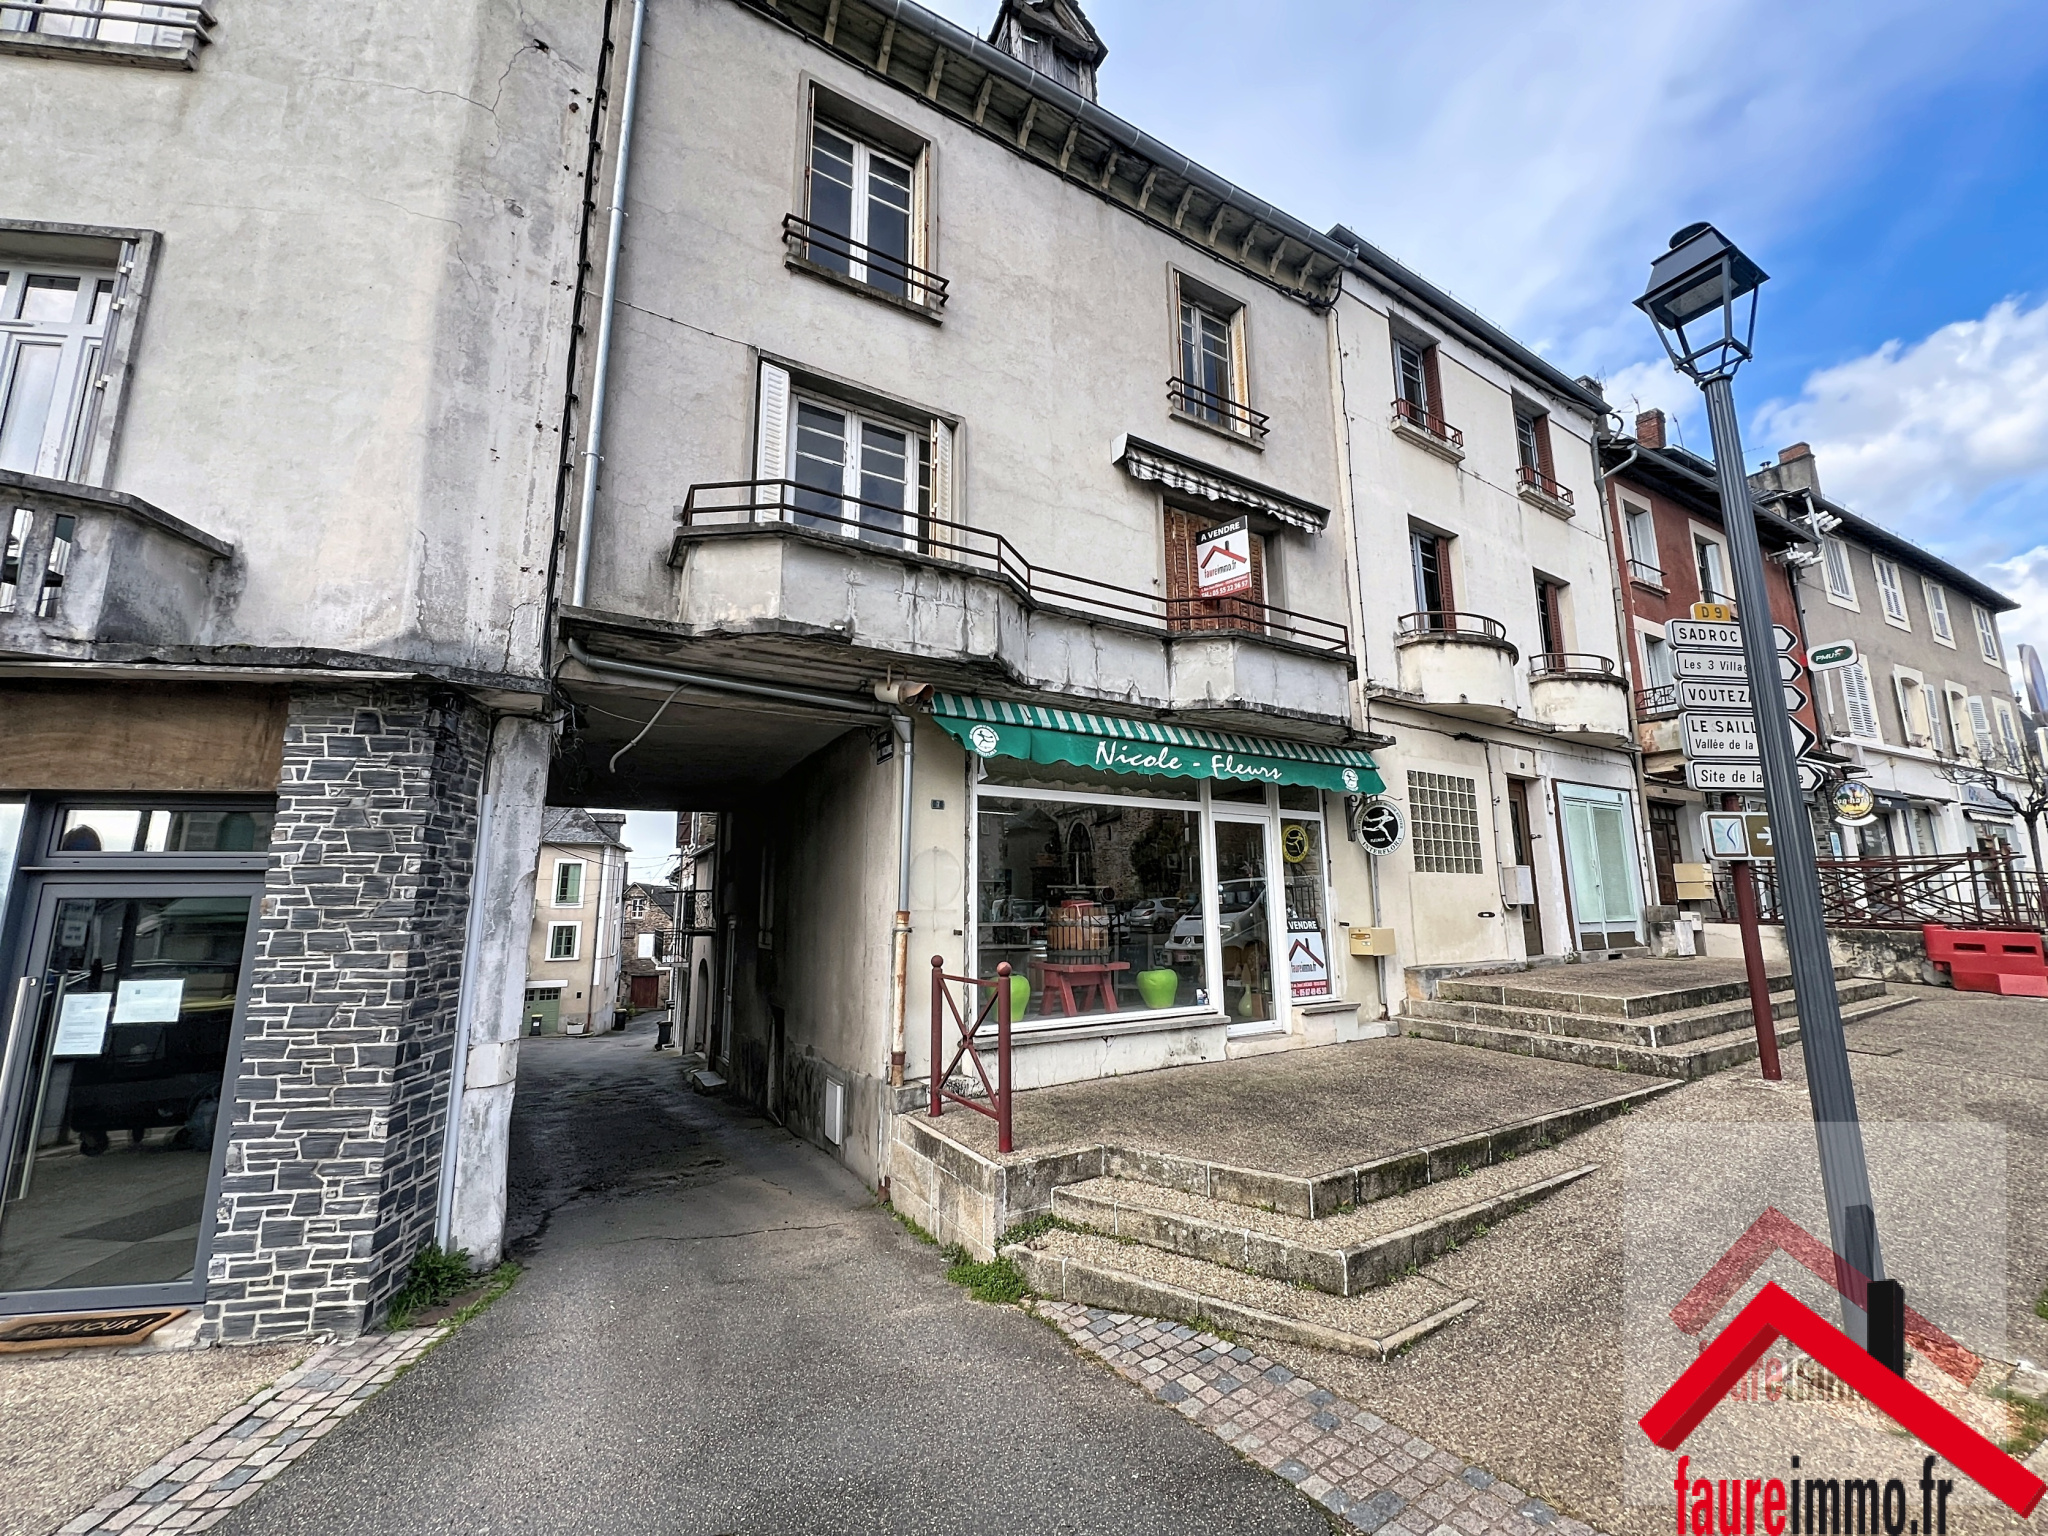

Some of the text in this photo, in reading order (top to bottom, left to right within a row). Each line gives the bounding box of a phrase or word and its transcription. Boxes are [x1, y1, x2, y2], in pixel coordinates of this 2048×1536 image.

[1201, 522, 1240, 541] A VENDRE
[1701, 606, 1723, 618] D 9
[1679, 627, 1738, 642] SADROC
[1815, 652, 1835, 662] PMU
[1684, 659, 1702, 670] Les
[1708, 660, 1714, 670] 3
[1688, 688, 1751, 703] VOUTEZ
[1691, 720, 1708, 733] LE
[1695, 739, 1754, 750] Vallée de la
[1095, 741, 1183, 769] Nicole
[1211, 755, 1283, 780] Fleurs
[1701, 770, 1763, 783] Site de la
[1361, 837, 1402, 855] INTERFLORA
[1288, 921, 1318, 930] VENDRE
